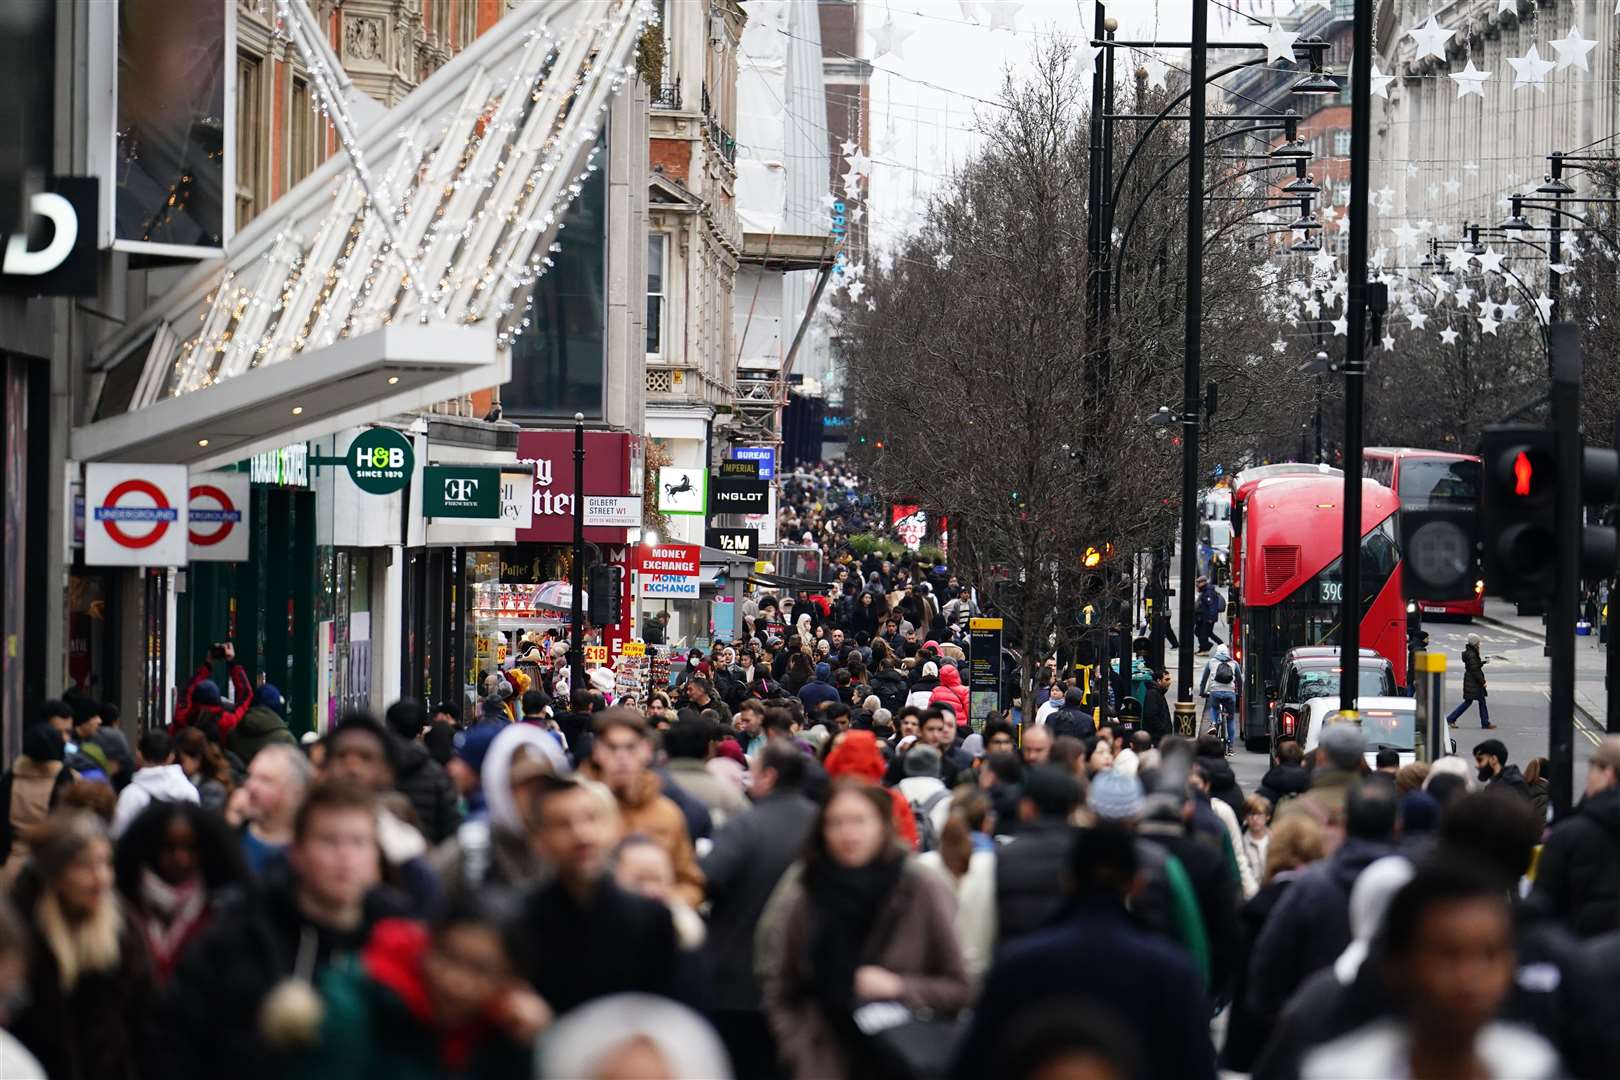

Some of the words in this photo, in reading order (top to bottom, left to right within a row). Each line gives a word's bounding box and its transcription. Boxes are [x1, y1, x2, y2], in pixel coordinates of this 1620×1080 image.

[356, 447, 404, 468] H&B
[737, 451, 770, 460] BUREAU
[723, 463, 755, 473] IMPERIAL
[356, 470, 382, 478] SINCE
[717, 492, 763, 501] INGLOT
[589, 498, 617, 506] GILBERT
[98, 508, 176, 520] UNDERGROUND
[589, 507, 614, 515] STREET
[616, 507, 626, 515] W1
[652, 549, 686, 559] MONEY
[501, 561, 528, 577] Potter
[643, 560, 694, 571] EXCHANGE
[652, 574, 688, 582] MONEY
[644, 583, 696, 593] EXCHANGE
[586, 648, 606, 660] £18
